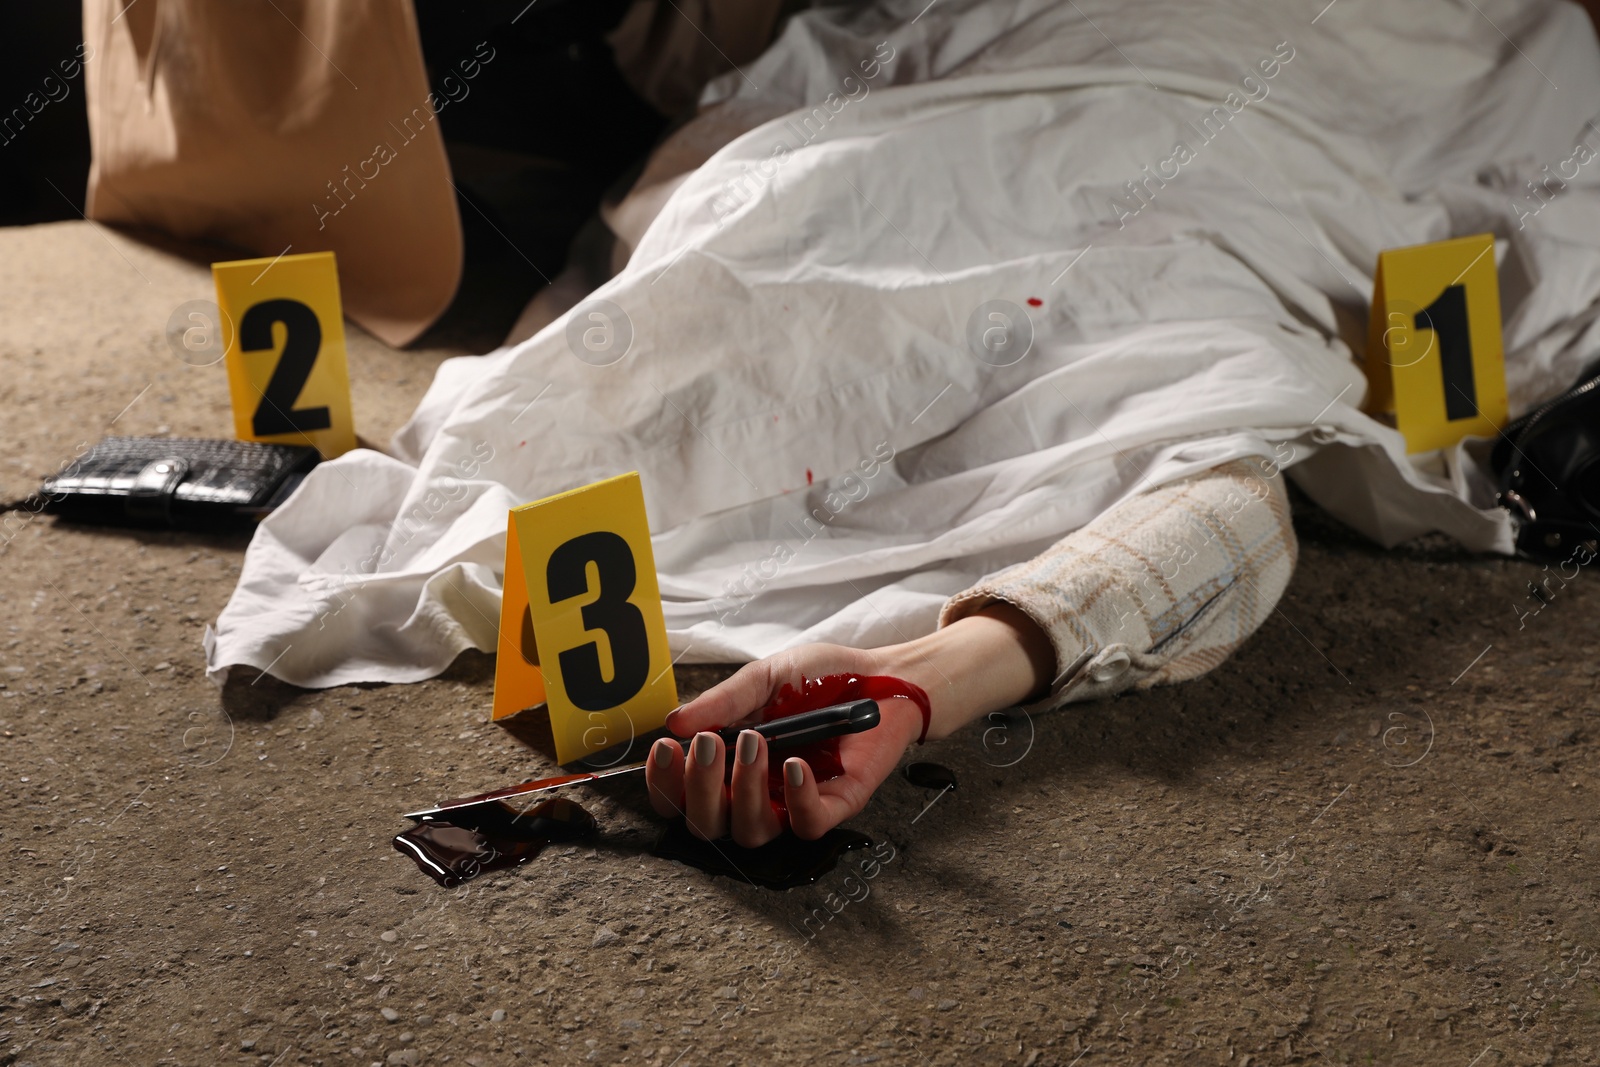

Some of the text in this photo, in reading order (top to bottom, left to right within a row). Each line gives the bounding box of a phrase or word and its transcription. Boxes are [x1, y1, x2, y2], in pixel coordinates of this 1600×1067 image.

[240, 298, 331, 436] 2
[1414, 284, 1478, 422] 1
[546, 531, 649, 711] 3
